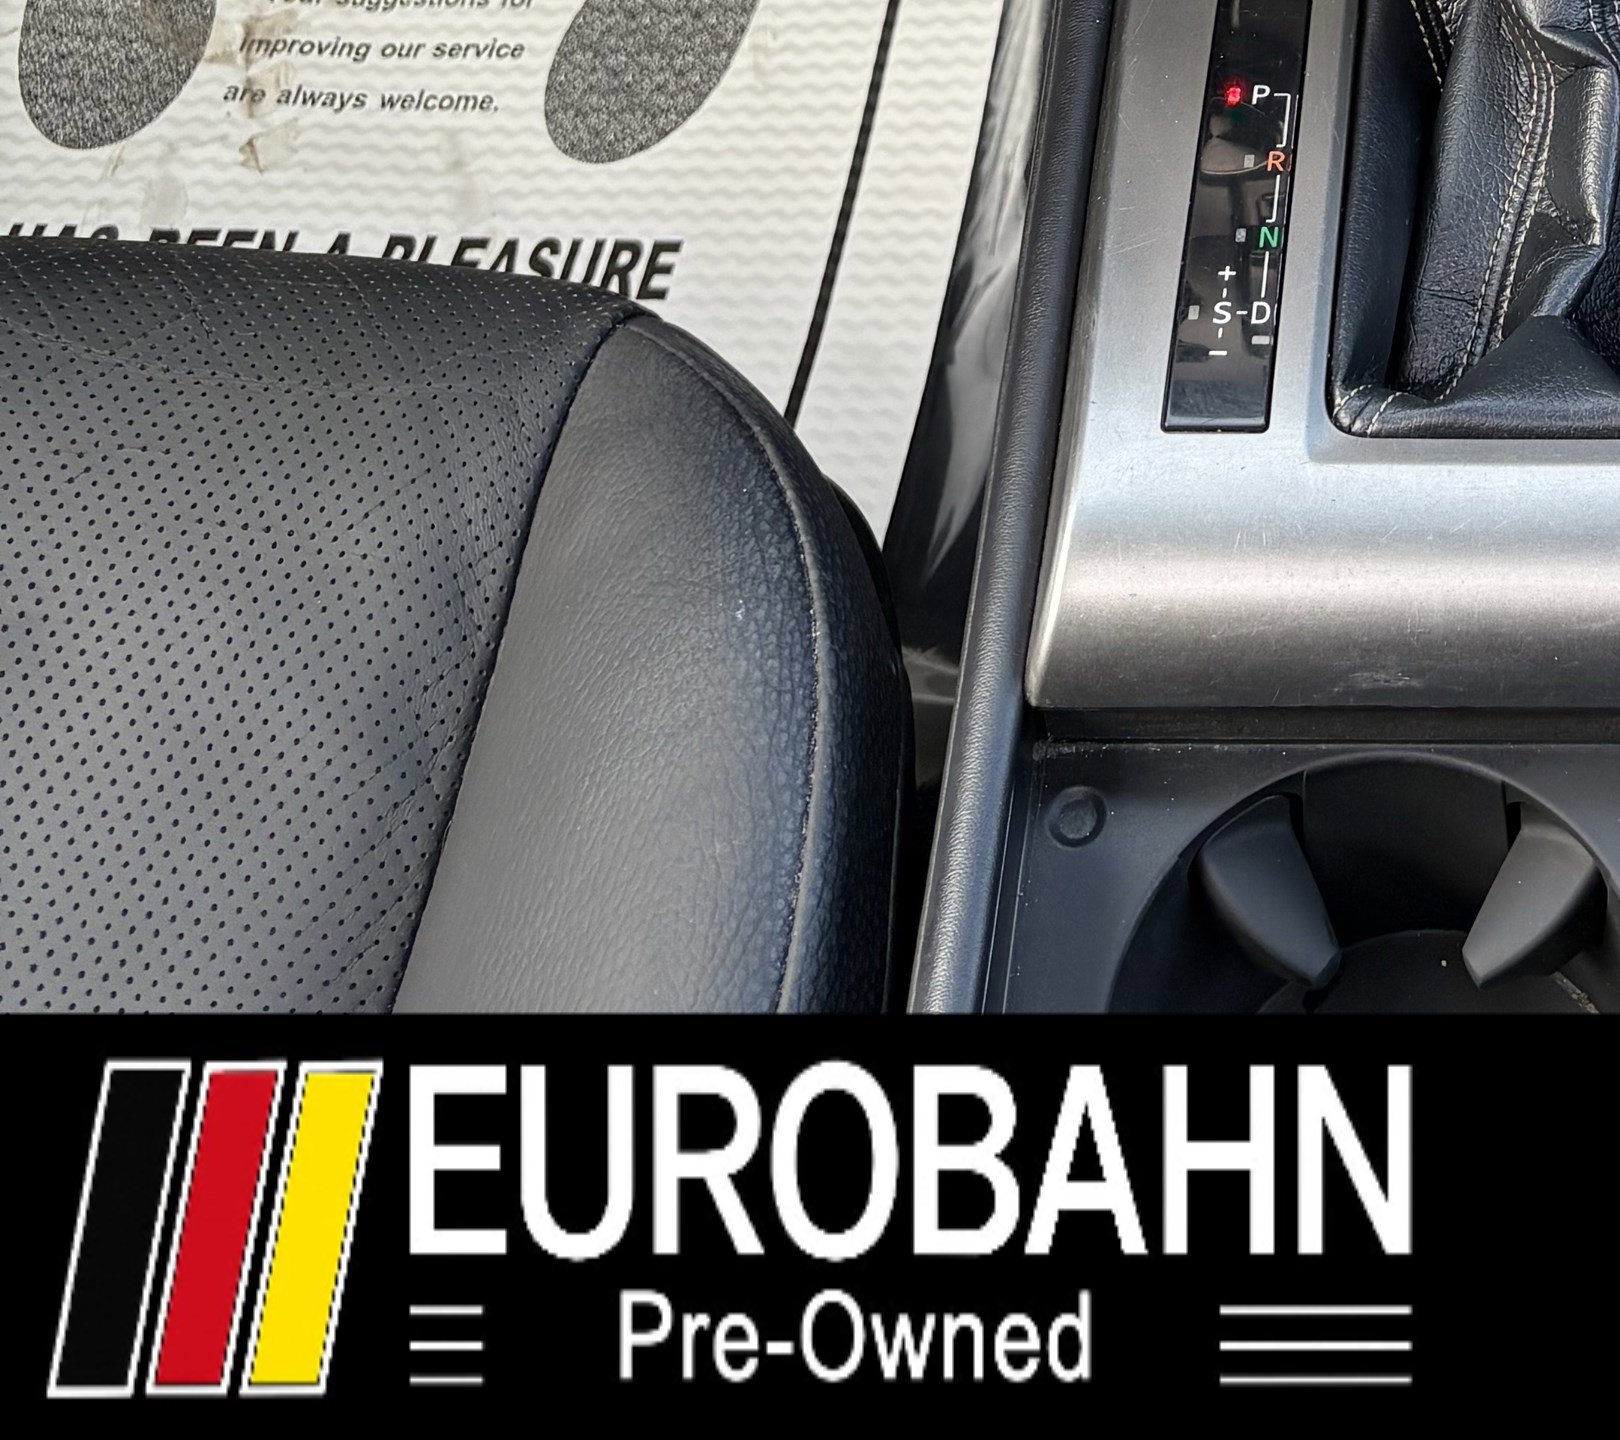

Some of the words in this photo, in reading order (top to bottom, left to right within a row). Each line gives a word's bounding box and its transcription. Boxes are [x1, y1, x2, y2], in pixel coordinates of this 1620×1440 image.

[238, 35, 372, 62] improving
[380, 43, 426, 59] our
[432, 37, 526, 59] service
[223, 84, 267, 104] are
[276, 85, 369, 113] always
[379, 90, 500, 113] welcome.
[1252, 86, 1271, 105] P
[1267, 151, 1286, 173] R
[1259, 227, 1279, 249] N
